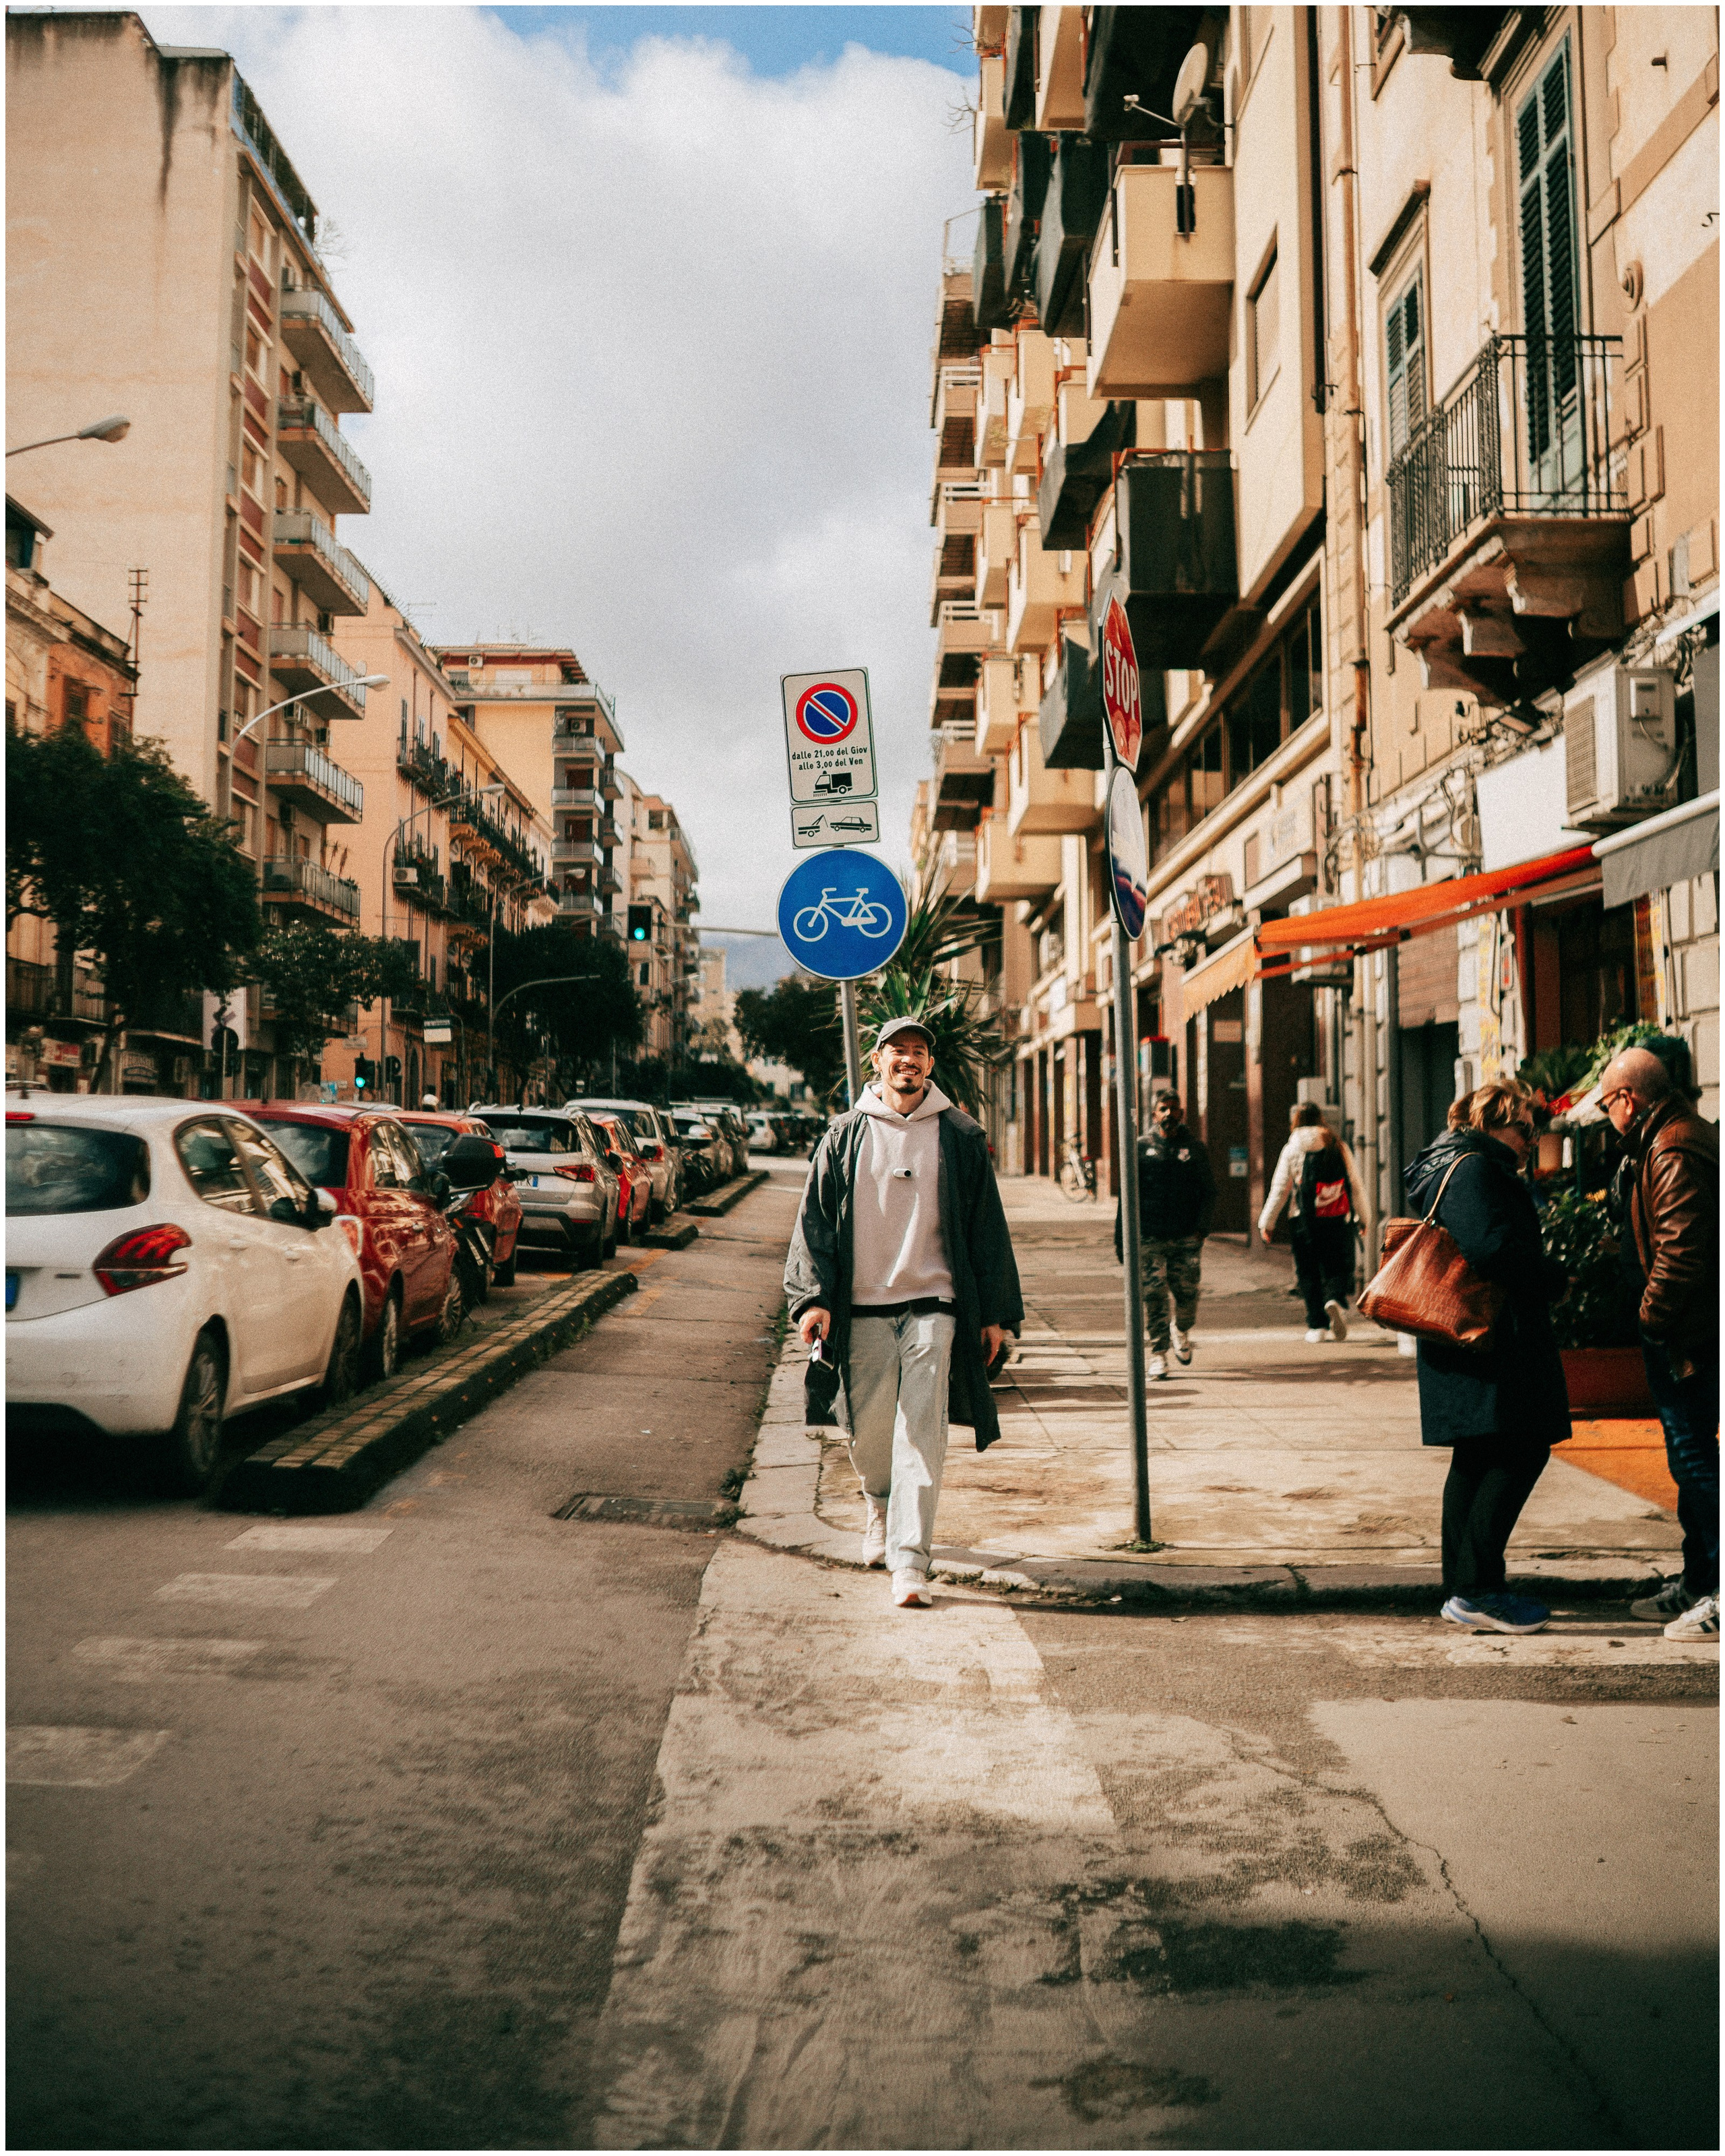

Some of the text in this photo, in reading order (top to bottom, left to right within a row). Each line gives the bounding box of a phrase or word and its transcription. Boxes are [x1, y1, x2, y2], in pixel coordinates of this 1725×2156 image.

[1105, 639, 1137, 720] STOP
[792, 746, 868, 760] dalle 21.00 del Giov
[798, 757, 863, 770] alle 3.00 del Ven
